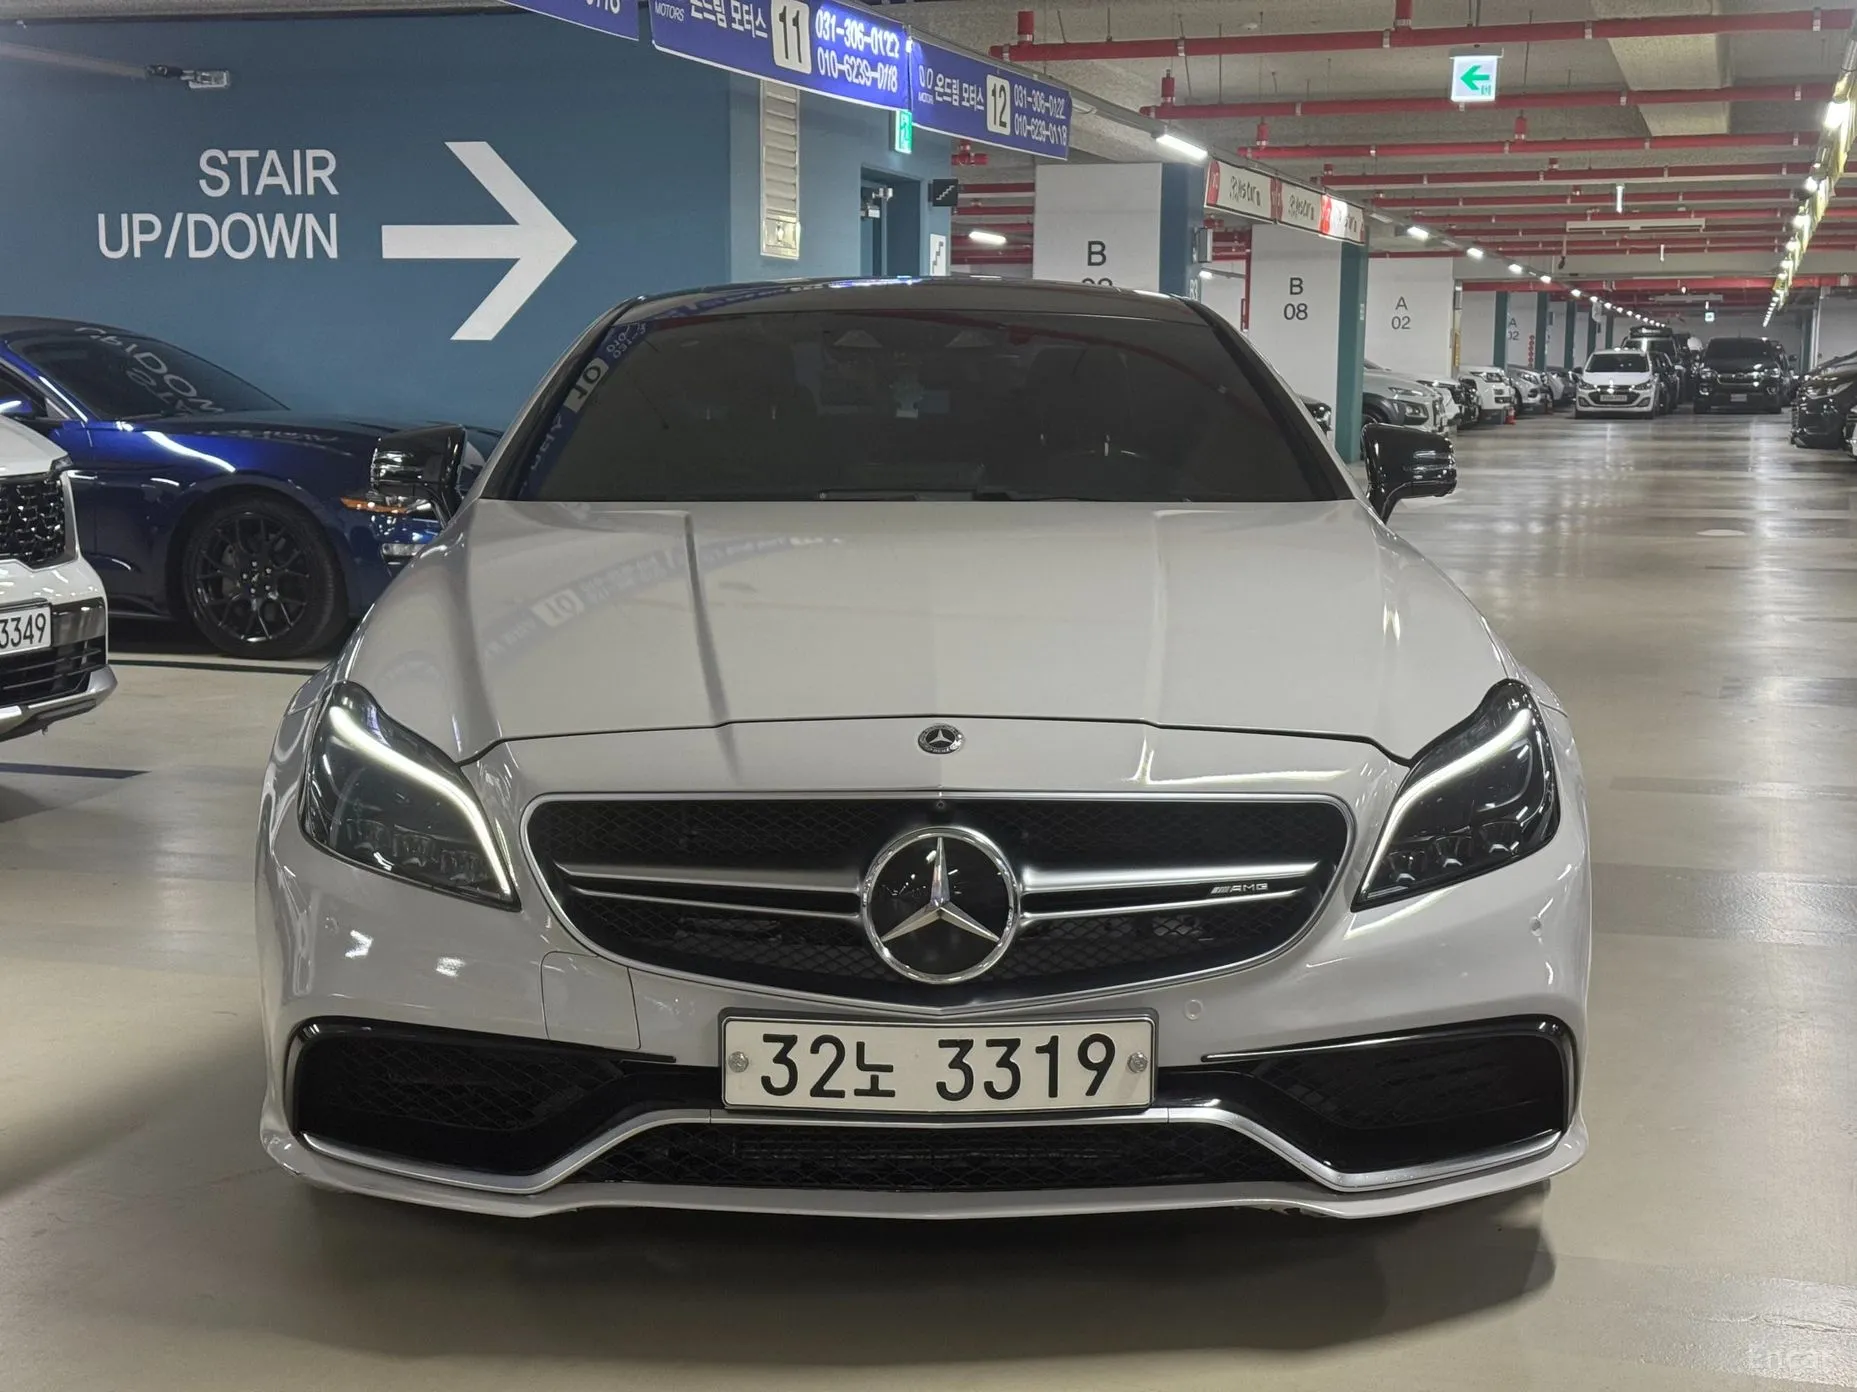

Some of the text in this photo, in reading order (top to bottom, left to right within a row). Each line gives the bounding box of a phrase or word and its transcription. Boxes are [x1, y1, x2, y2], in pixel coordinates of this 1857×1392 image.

[778, 5, 803, 64] 11
[815, 9, 900, 59] 031-306-0122
[817, 46, 898, 93] 010-6239-0118
[935, 73, 960, 107] 온드림
[962, 83, 985, 111] 모터스
[991, 83, 1008, 129] 12
[199, 148, 340, 198] STAIR
[97, 212, 339, 260] UP/DOWN
[1087, 240, 1107, 266] B
[1290, 277, 1304, 295] B
[1395, 296, 1408, 311] A
[1283, 303, 1308, 320] 08
[1391, 316, 1411, 330] 02
[0, 612, 46, 649] 3349
[760, 1033, 1116, 1101] 32노 3319
